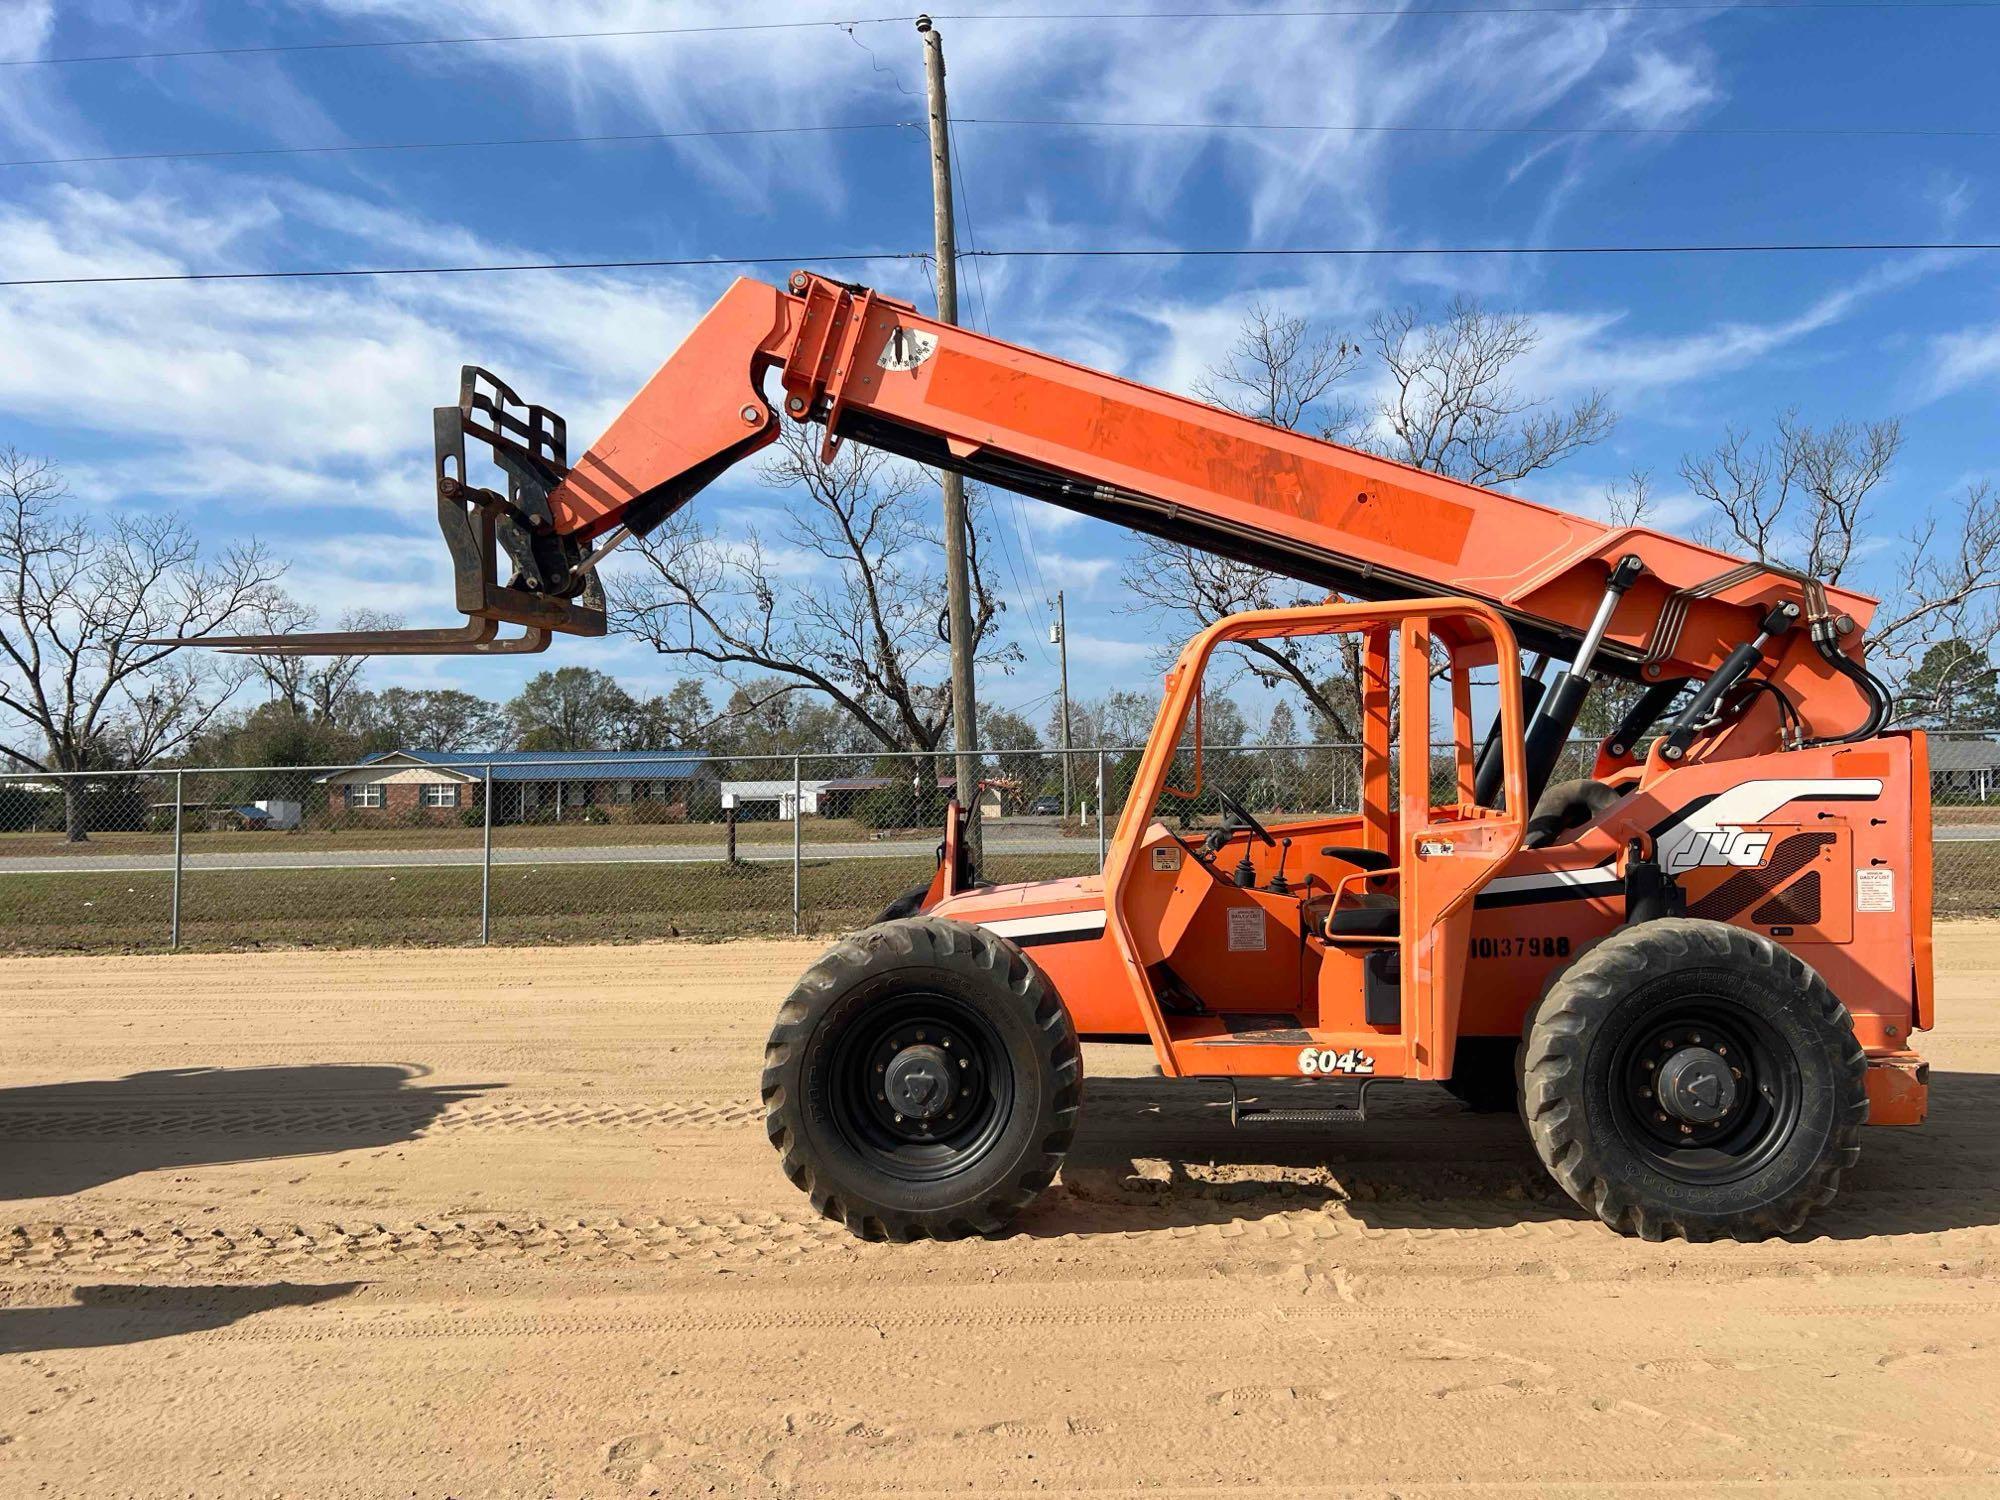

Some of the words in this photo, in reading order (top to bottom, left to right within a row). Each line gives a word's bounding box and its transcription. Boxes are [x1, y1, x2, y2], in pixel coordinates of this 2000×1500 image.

[1672, 832, 1773, 867] JLG
[1470, 936, 1570, 959] 10137988
[1297, 1047, 1375, 1074] 6042
